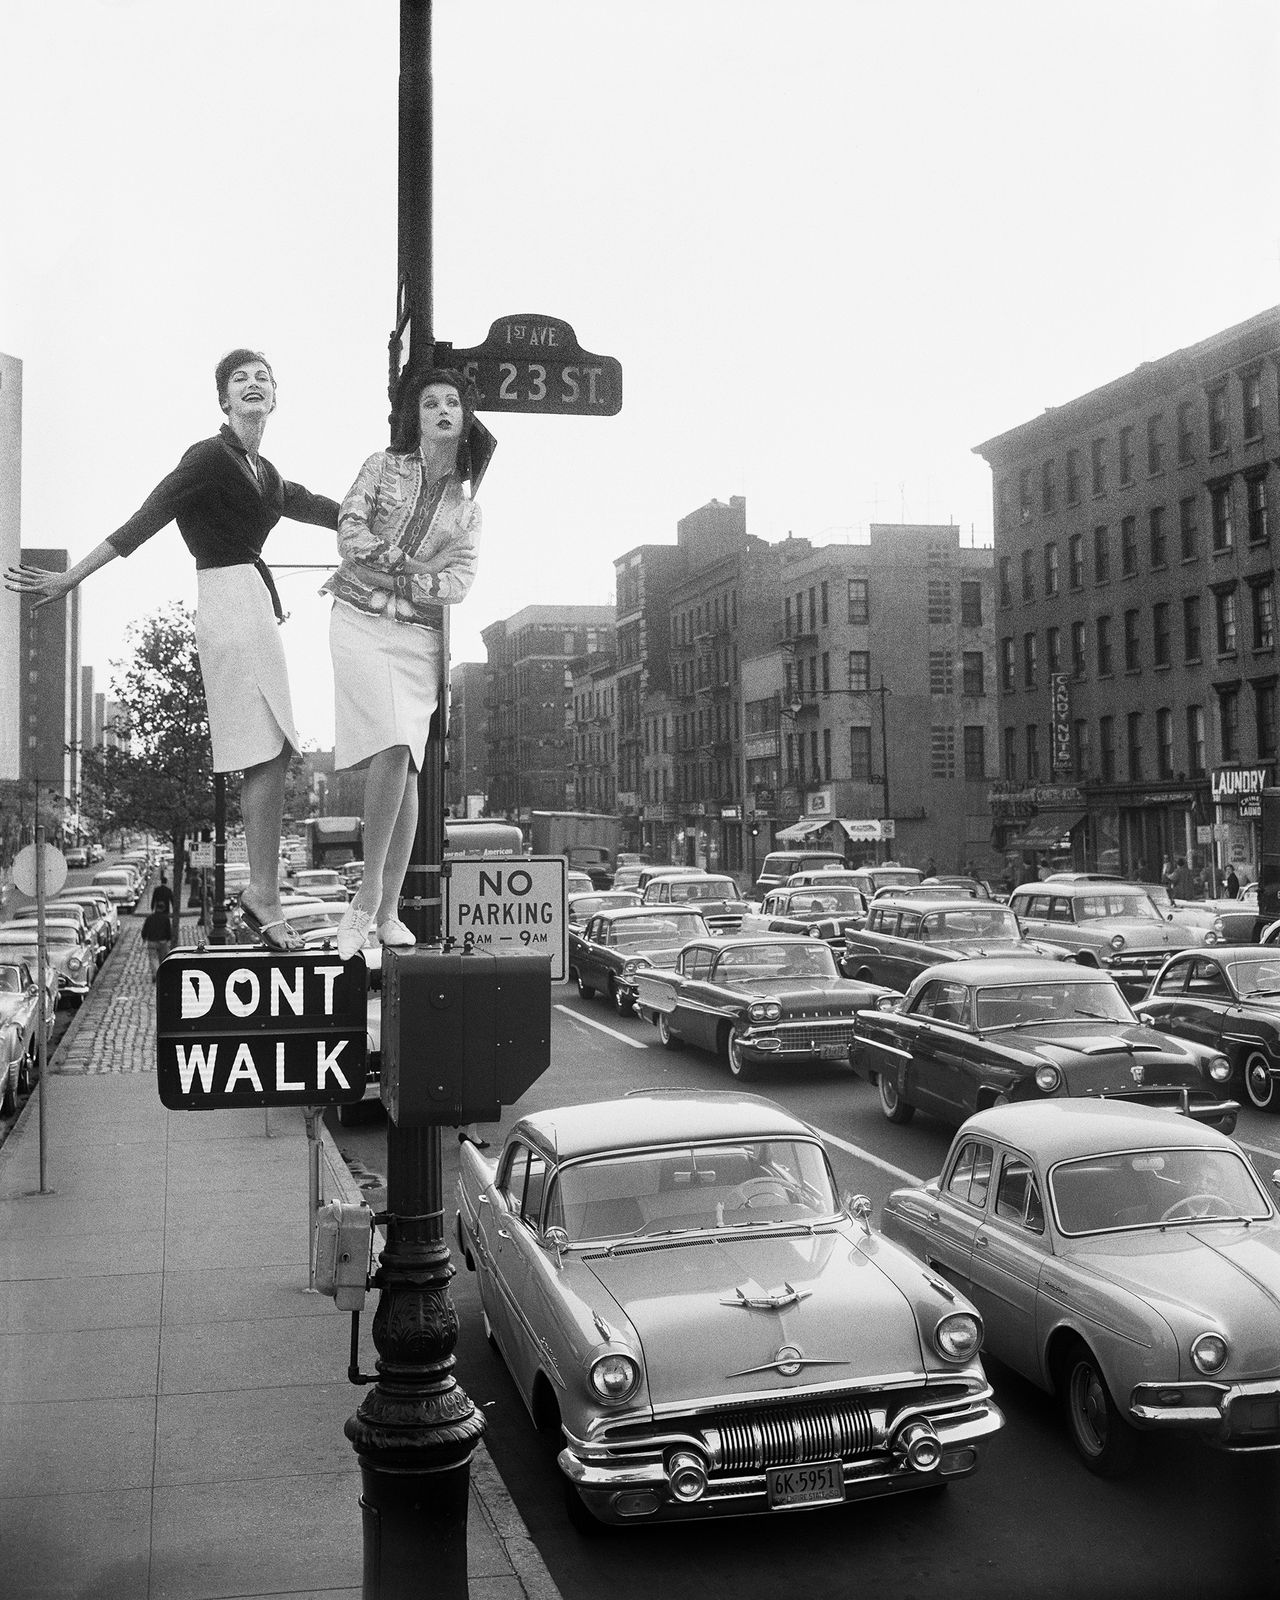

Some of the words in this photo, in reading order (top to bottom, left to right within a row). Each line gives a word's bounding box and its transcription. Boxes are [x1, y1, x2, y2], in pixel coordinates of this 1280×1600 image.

[499, 363, 547, 401] 23
[1057, 724, 1070, 760] NUTS
[1211, 770, 1266, 794] LAUNDRY
[479, 870, 533, 896] NO
[458, 902, 553, 925] PARKING
[519, 930, 548, 946] 9AM
[181, 966, 344, 1019] DONT
[175, 1040, 351, 1094] WALK
